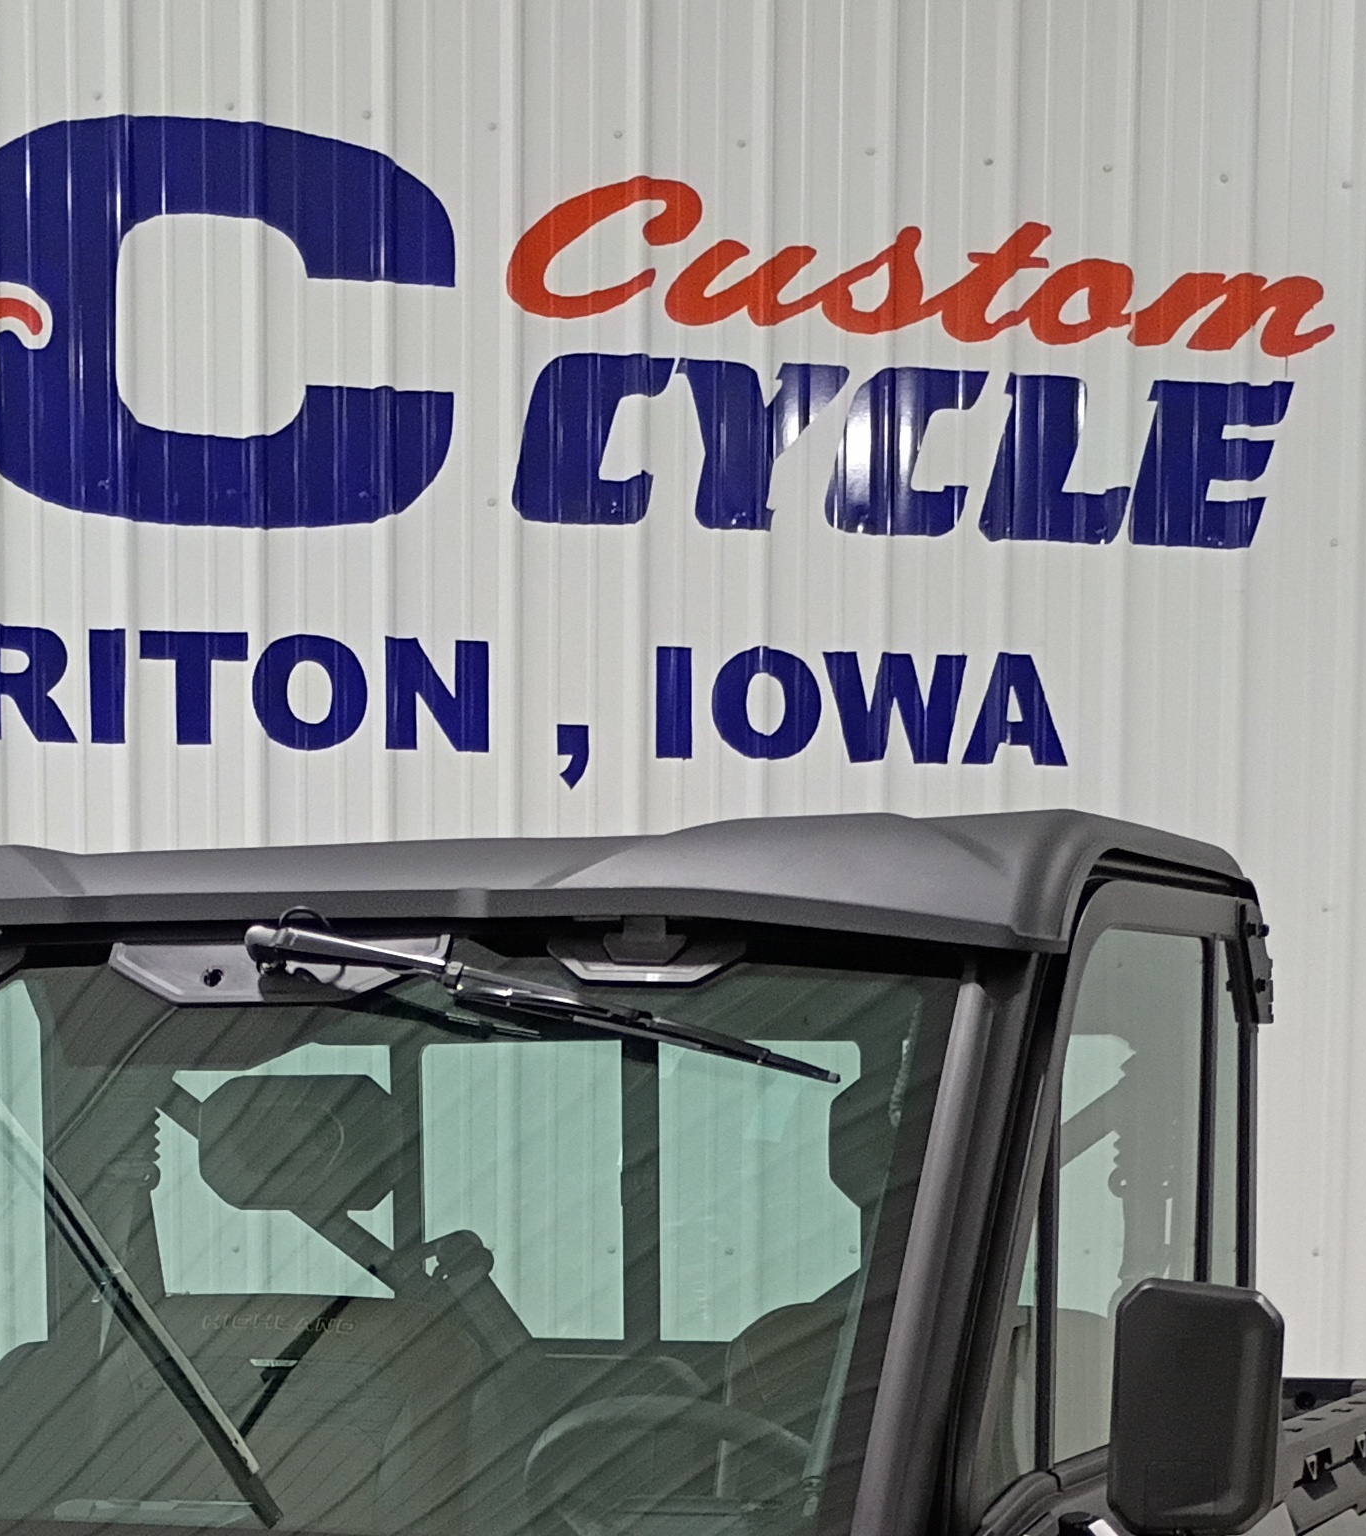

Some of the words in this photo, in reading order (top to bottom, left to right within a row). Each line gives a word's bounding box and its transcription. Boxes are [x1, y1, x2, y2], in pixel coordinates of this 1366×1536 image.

[507, 176, 1335, 358] Custom
[513, 353, 1295, 550] CYCLE
[656, 646, 1067, 766] IOWA
